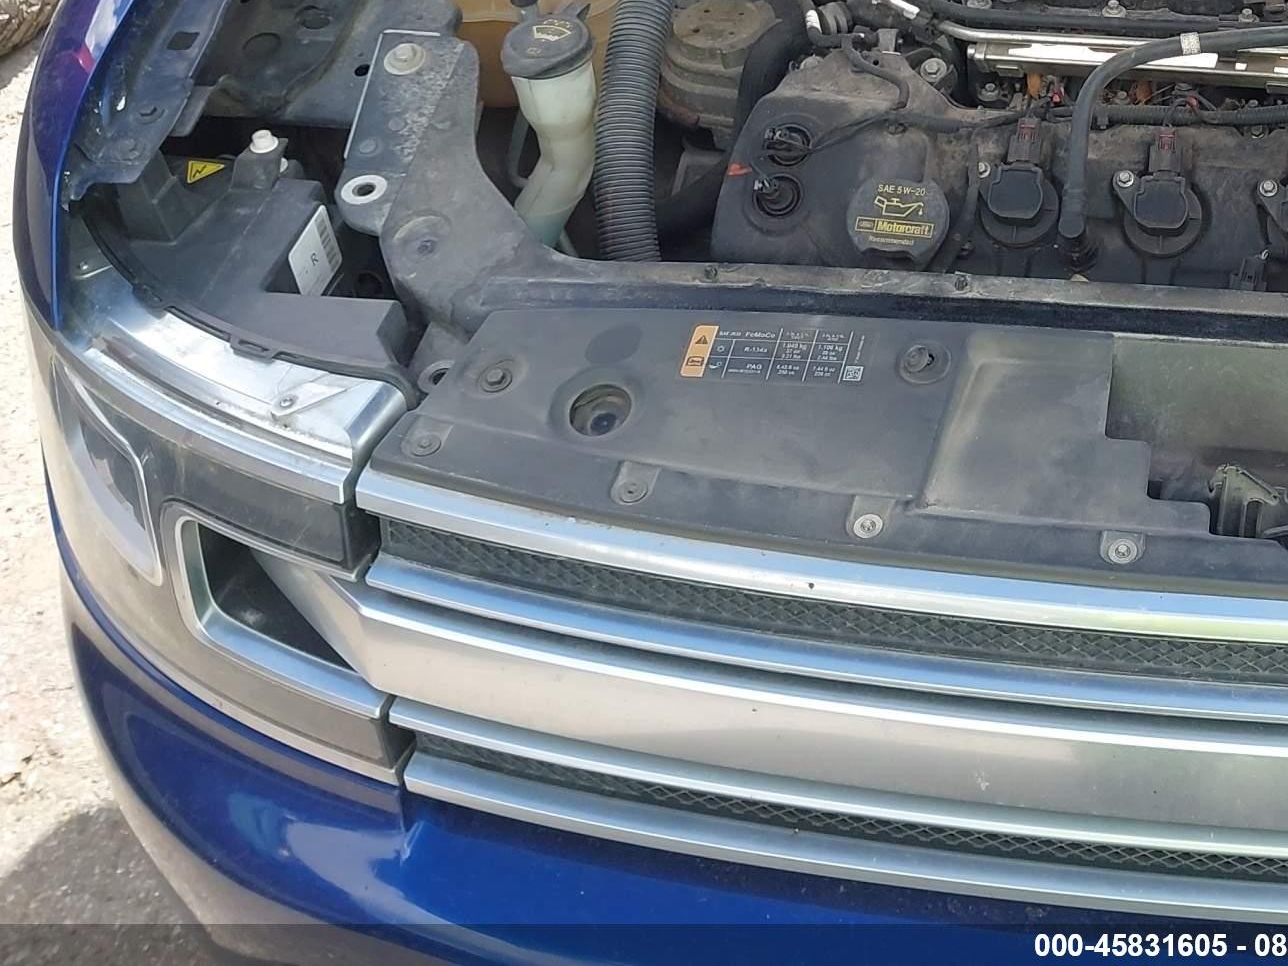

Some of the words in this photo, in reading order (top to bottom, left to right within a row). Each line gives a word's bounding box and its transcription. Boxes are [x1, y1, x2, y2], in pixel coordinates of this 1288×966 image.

[878, 184, 896, 194] SAE
[897, 186, 926, 196] 5W-20
[876, 220, 930, 235] Motorcraft
